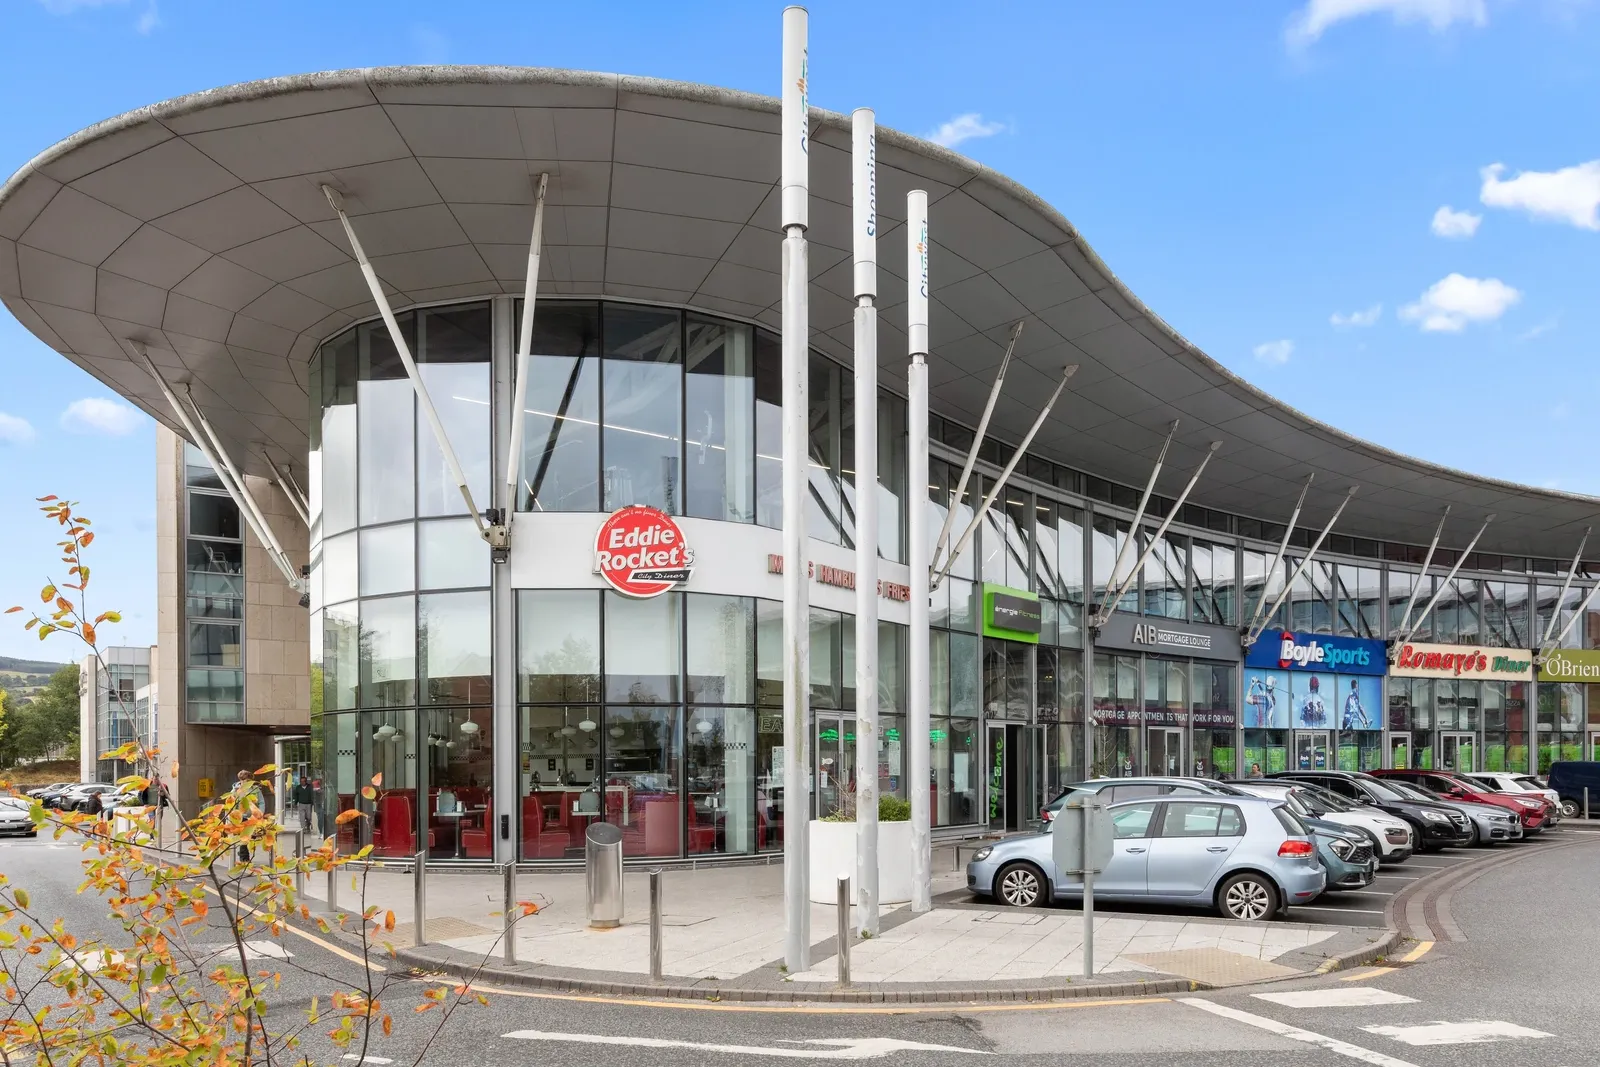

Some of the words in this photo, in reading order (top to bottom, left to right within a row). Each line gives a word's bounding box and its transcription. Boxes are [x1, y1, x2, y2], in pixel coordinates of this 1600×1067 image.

[609, 525, 675, 549] Eddie
[594, 541, 695, 572] Rocket's
[884, 581, 910, 602] FRIES
[1133, 623, 1157, 645] AIB
[1158, 633, 1188, 644] MORTGAGE
[1190, 637, 1211, 647] LOUNGE
[1281, 639, 1370, 668] BoyleSports
[1397, 645, 1487, 676] Romayo's
[1491, 655, 1531, 672] Diner
[1546, 653, 1600, 677] O'Brien
[760, 716, 784, 732] EA
[1093, 709, 1125, 720] MORTGAGE
[1127, 711, 1173, 721] APPONTMENTS
[1174, 713, 1188, 721] THAT
[1208, 714, 1221, 723] FOR
[1222, 715, 1234, 723] YOU
[990, 737, 1004, 818] welcome
